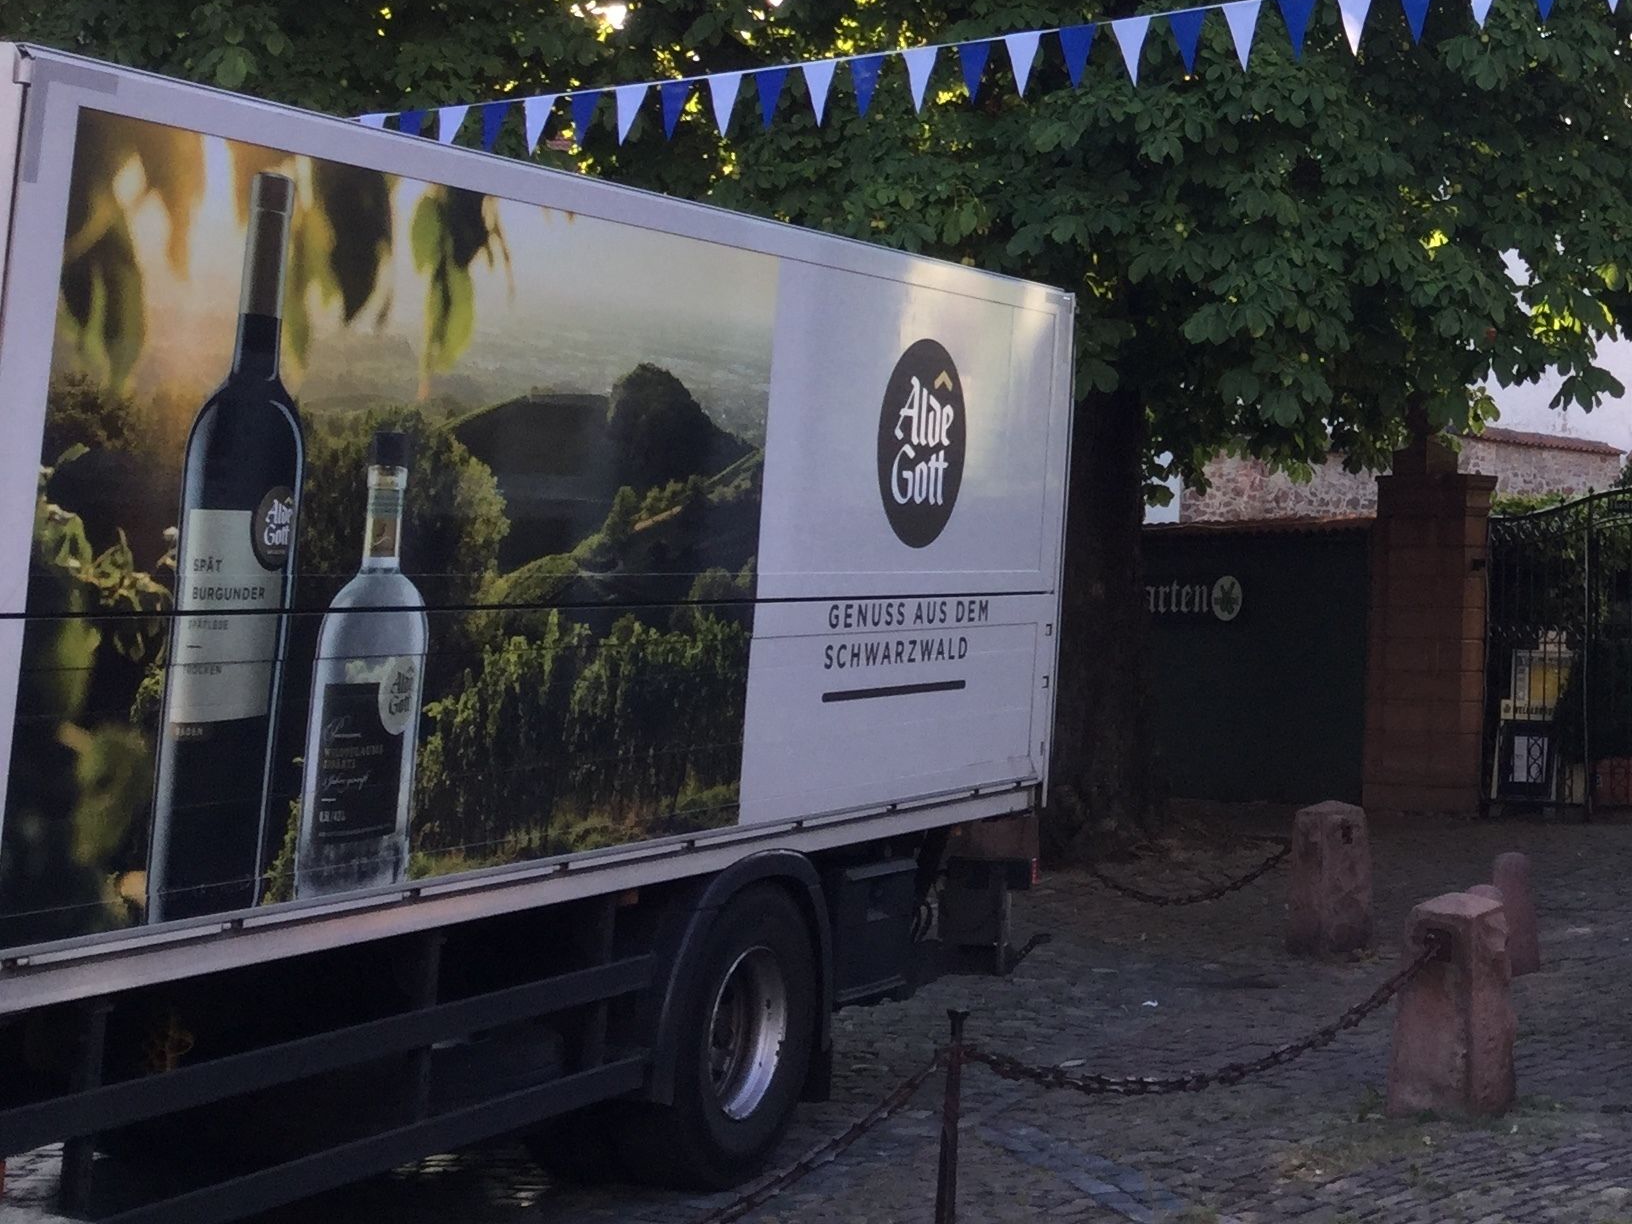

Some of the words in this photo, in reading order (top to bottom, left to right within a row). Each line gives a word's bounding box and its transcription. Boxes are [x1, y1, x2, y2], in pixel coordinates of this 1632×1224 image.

[894, 375, 954, 448] Alde
[891, 443, 949, 506] Gott
[265, 498, 293, 524] Alde
[264, 524, 290, 546] Gott
[193, 556, 223, 572] SPÄT
[192, 586, 265, 601] BURGUNDER
[828, 601, 906, 629] GENUSS
[913, 600, 948, 625] AUS
[955, 599, 990, 623] DEM
[823, 636, 968, 670] SCHWARZWALD
